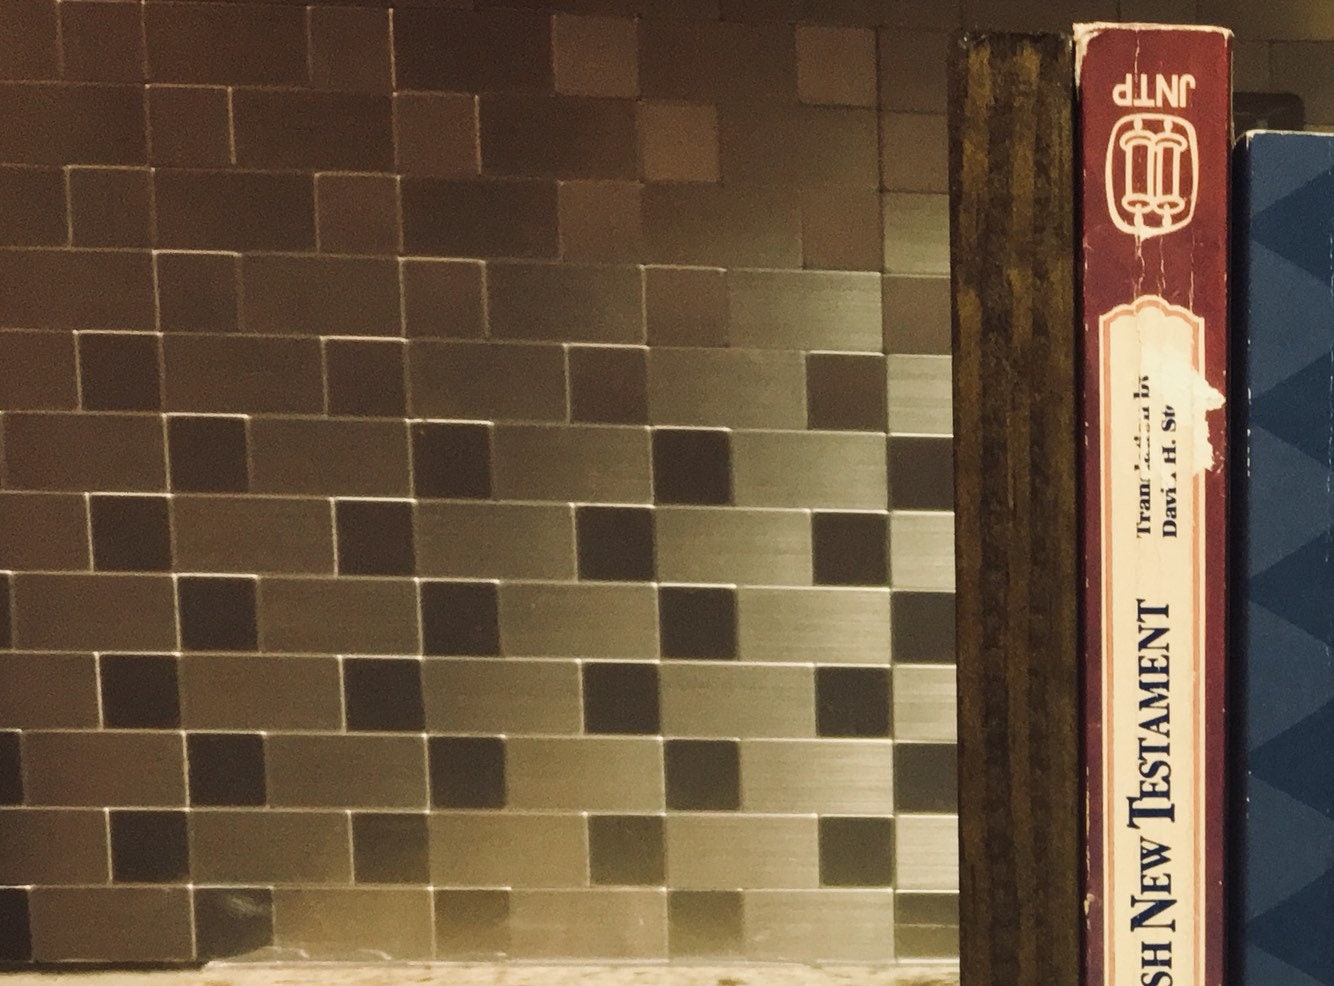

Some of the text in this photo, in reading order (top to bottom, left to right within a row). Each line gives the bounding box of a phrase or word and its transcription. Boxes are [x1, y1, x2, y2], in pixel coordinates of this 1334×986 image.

[1112, 73, 1196, 108] JNTP
[1162, 438, 1177, 464] H.
[1160, 472, 1177, 539] Davi
[1126, 598, 1175, 829] TESTAMENT
[1130, 836, 1177, 932] NEW
